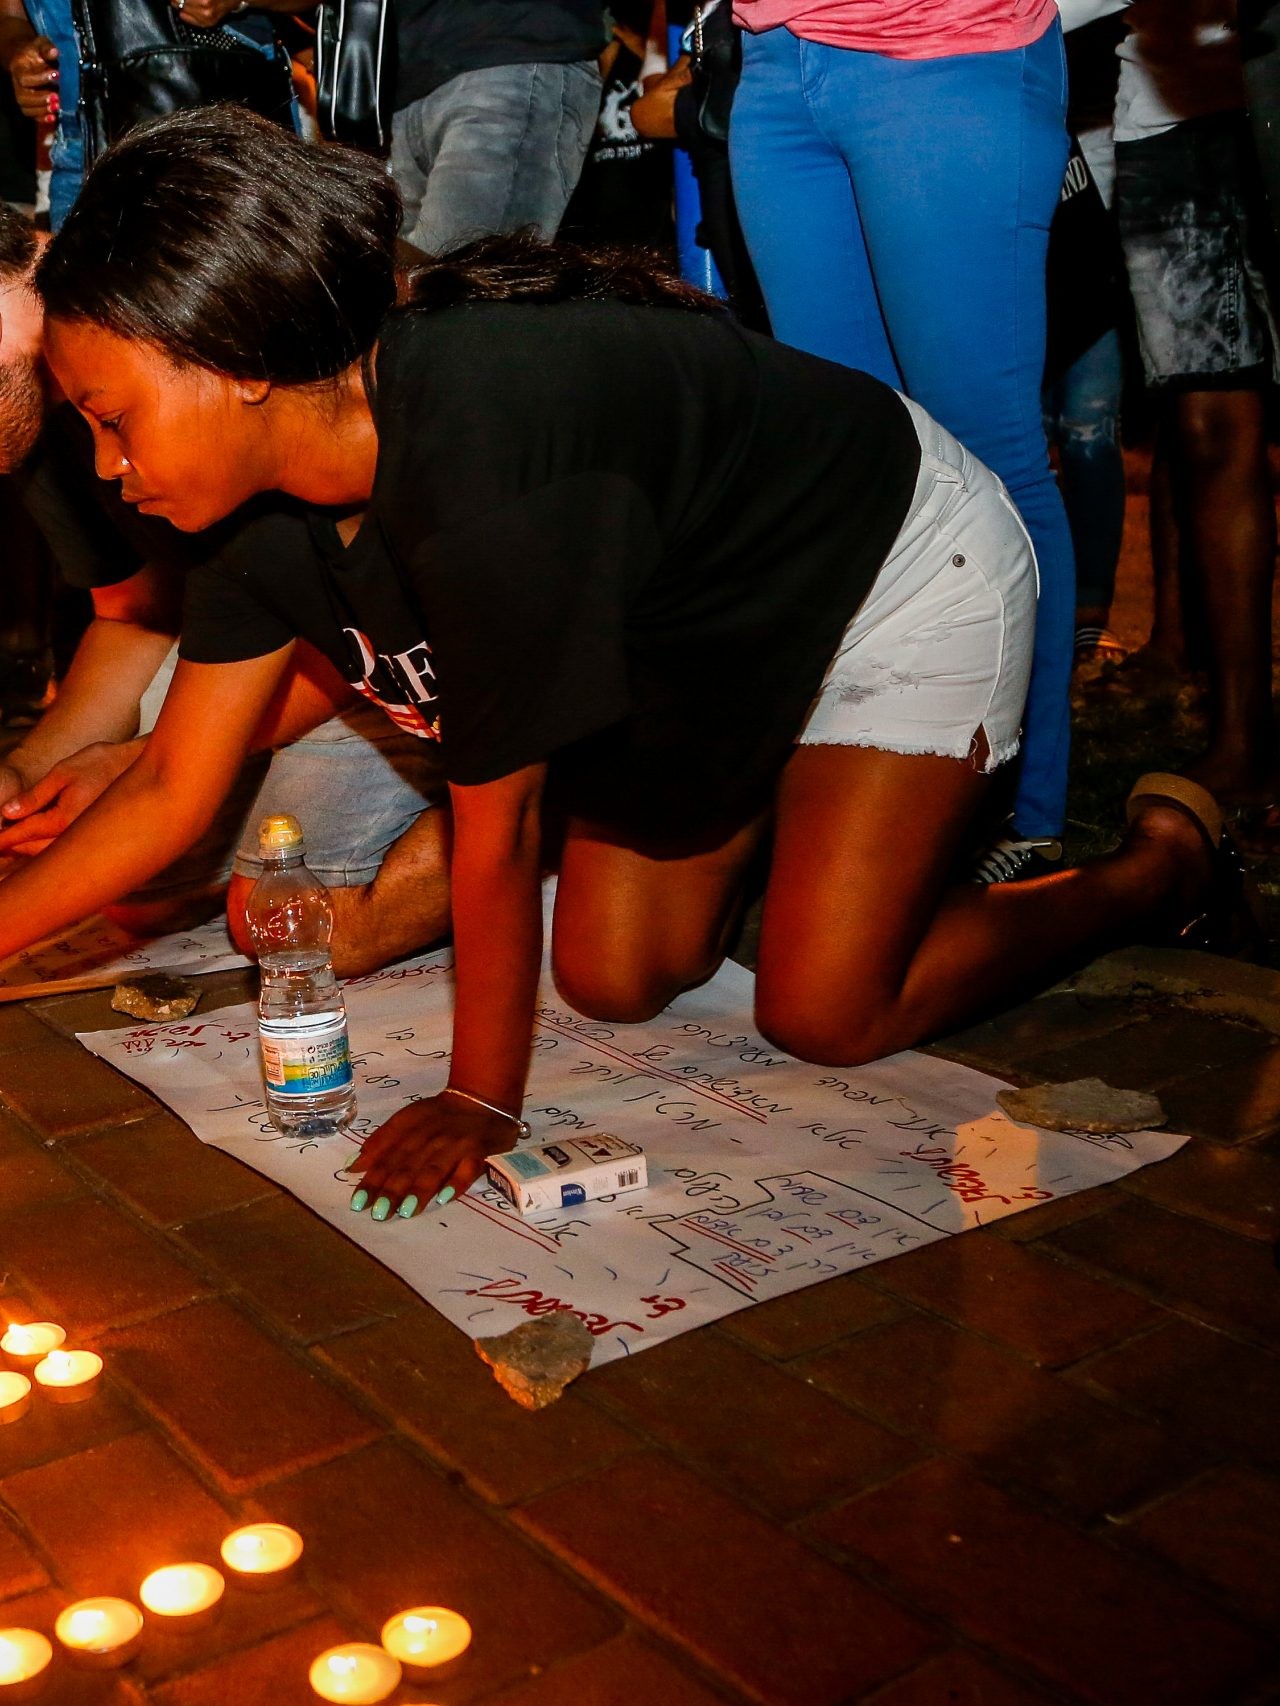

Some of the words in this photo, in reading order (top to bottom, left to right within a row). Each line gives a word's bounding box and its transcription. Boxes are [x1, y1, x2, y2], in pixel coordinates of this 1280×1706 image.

[220, 1032, 251, 1043] די
[632, 1044, 675, 1062] של
[815, 1076, 893, 1105] מפחד
[532, 1107, 596, 1131] מקום
[623, 1090, 722, 1131] מרטין
[798, 1122, 866, 1149] אלא
[664, 1168, 741, 1209] העולם
[1011, 1186, 1054, 1201] די
[744, 1206, 812, 1222] לבן
[830, 1208, 881, 1225] דם
[535, 1218, 591, 1241] אלו
[786, 1225, 833, 1239] דם
[872, 1227, 920, 1246] אין
[827, 1242, 877, 1260] אין
[639, 1294, 687, 1319] די
